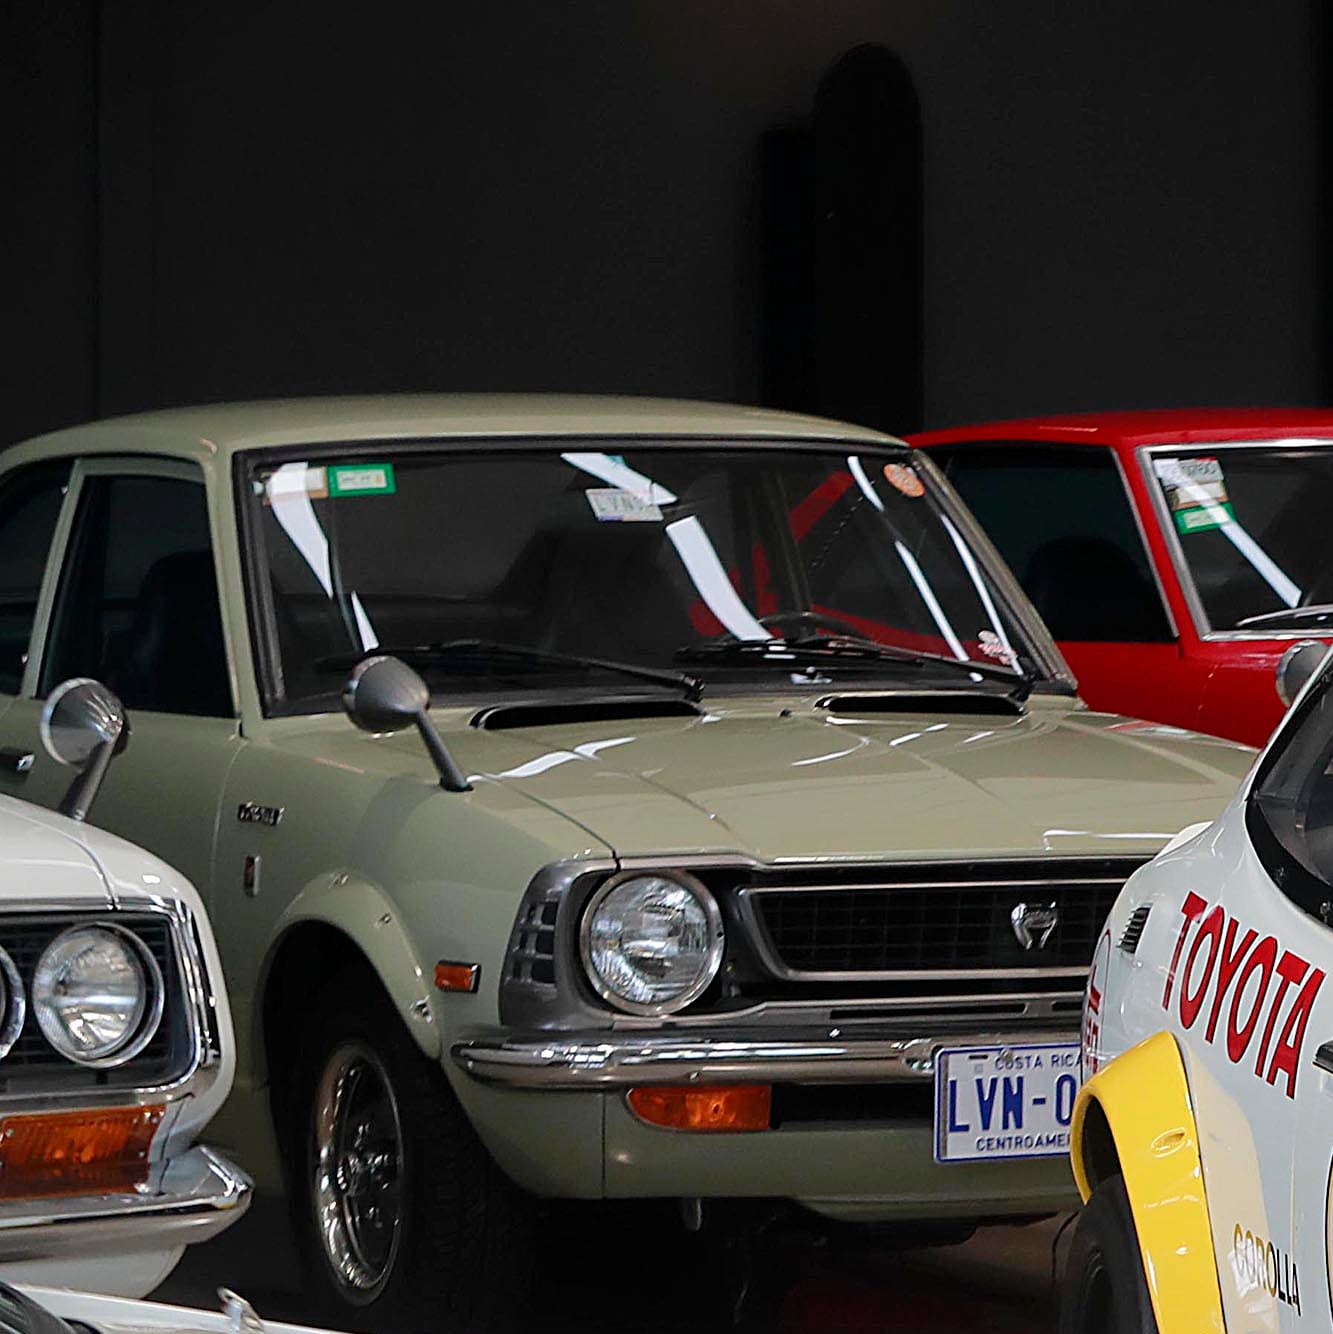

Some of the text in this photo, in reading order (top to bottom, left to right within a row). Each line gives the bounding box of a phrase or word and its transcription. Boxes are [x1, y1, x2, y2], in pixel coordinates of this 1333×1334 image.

[1161, 891, 1326, 1100] TOYOTA
[994, 1054, 1043, 1071] COSTA
[948, 1073, 1078, 1133] LVN-0
[1233, 1222, 1302, 1317] COROLLA
